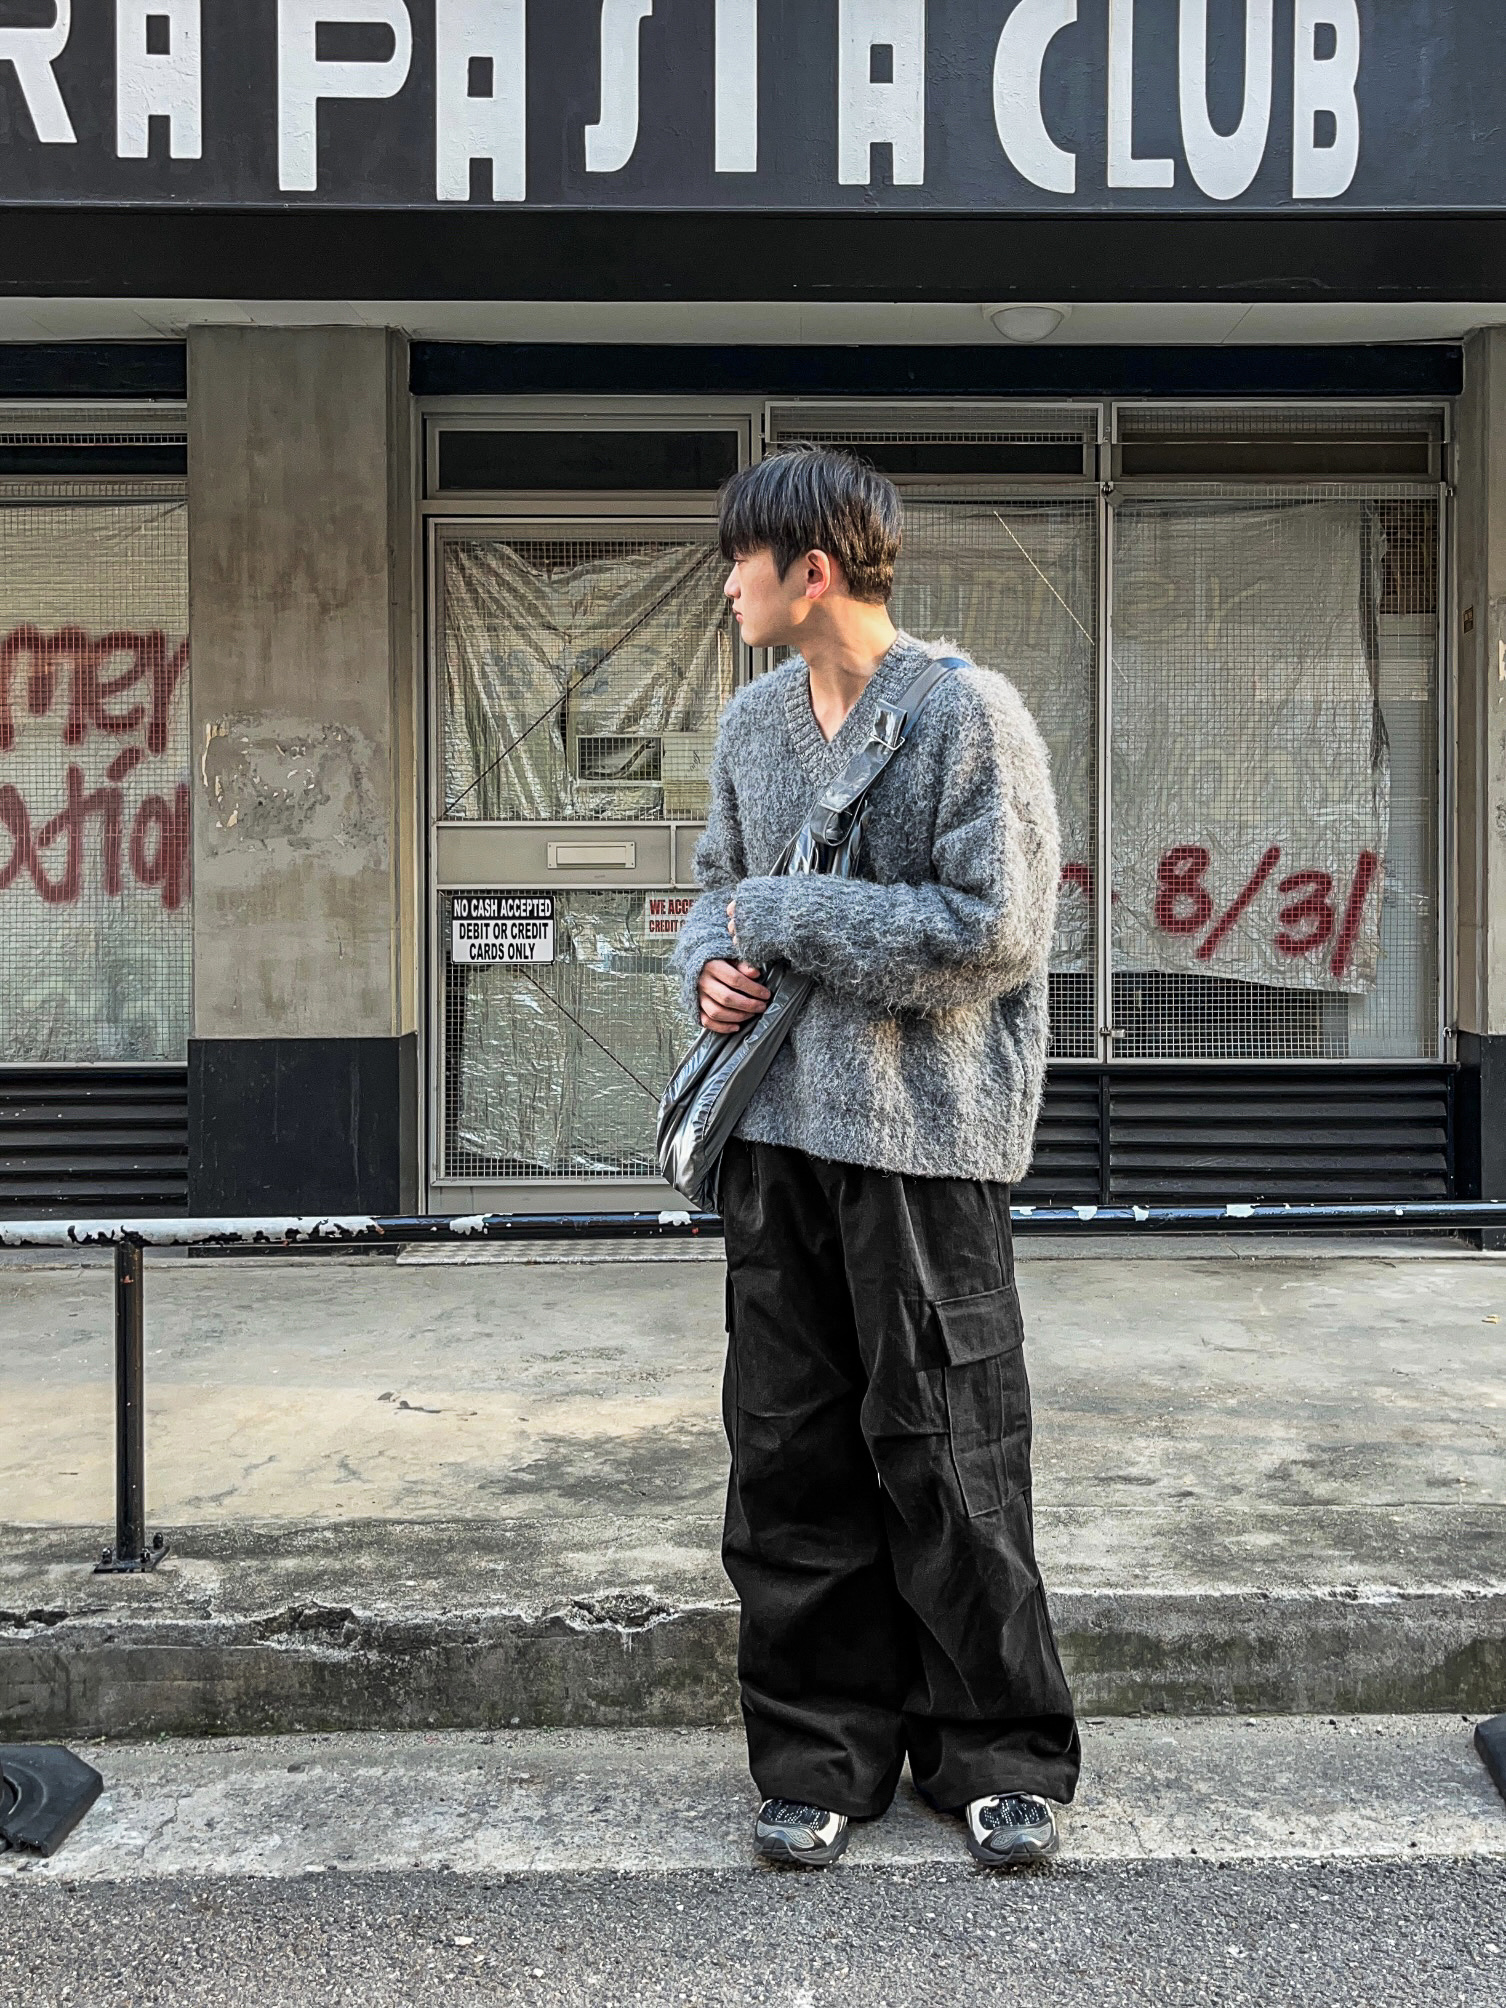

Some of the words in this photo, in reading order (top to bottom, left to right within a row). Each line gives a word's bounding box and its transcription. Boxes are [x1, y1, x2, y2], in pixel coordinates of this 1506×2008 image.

[993, 0, 1360, 200] CLUB
[454, 899, 469, 917] NO
[471, 899, 498, 917] CASH
[500, 899, 552, 917] ACCEPTED
[650, 899, 667, 915] WE
[459, 922, 490, 940] DEBIT
[493, 922, 508, 940] OR
[511, 922, 549, 940] CREDIT
[649, 919, 679, 933] CREDIT
[469, 943, 505, 960] CARDS
[507, 943, 536, 960] ONLY
